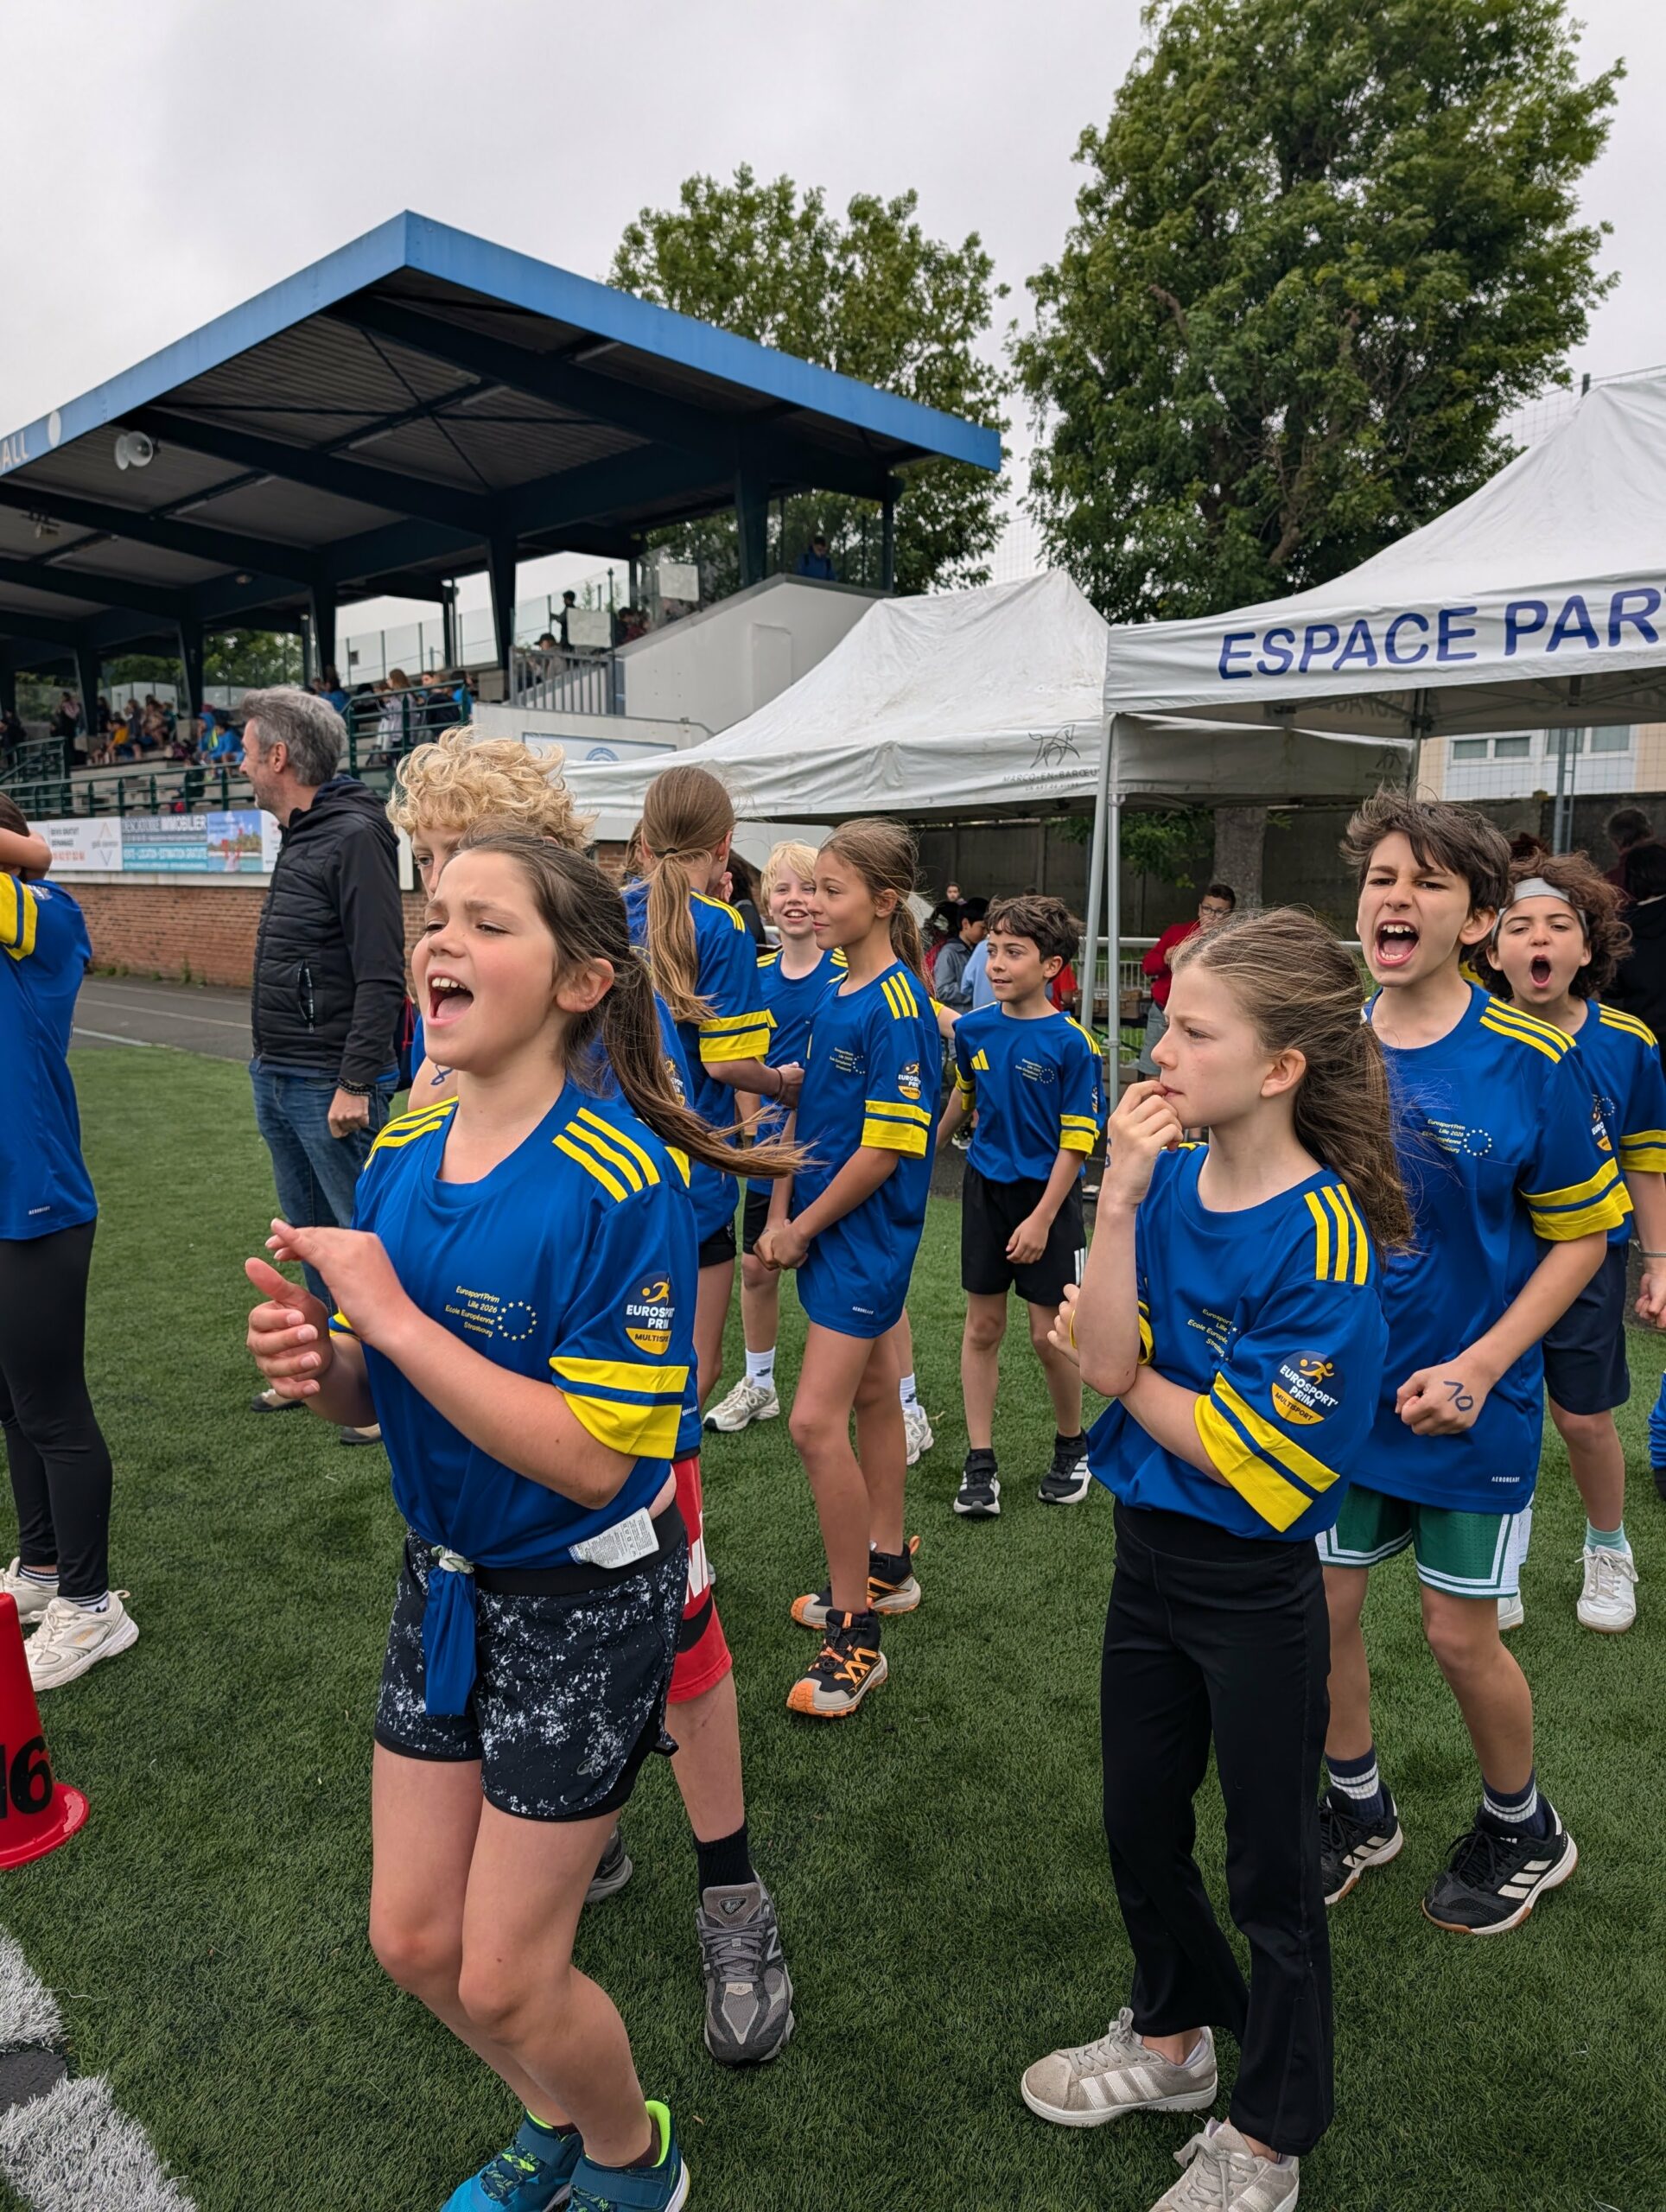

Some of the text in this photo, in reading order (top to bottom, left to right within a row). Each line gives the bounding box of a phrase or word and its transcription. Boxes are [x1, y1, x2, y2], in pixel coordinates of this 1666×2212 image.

[1218, 588, 1666, 680] ESPACE PAR
[1275, 1392, 1314, 1421] MULTISPORT
[1288, 1385, 1316, 1408] PRIM
